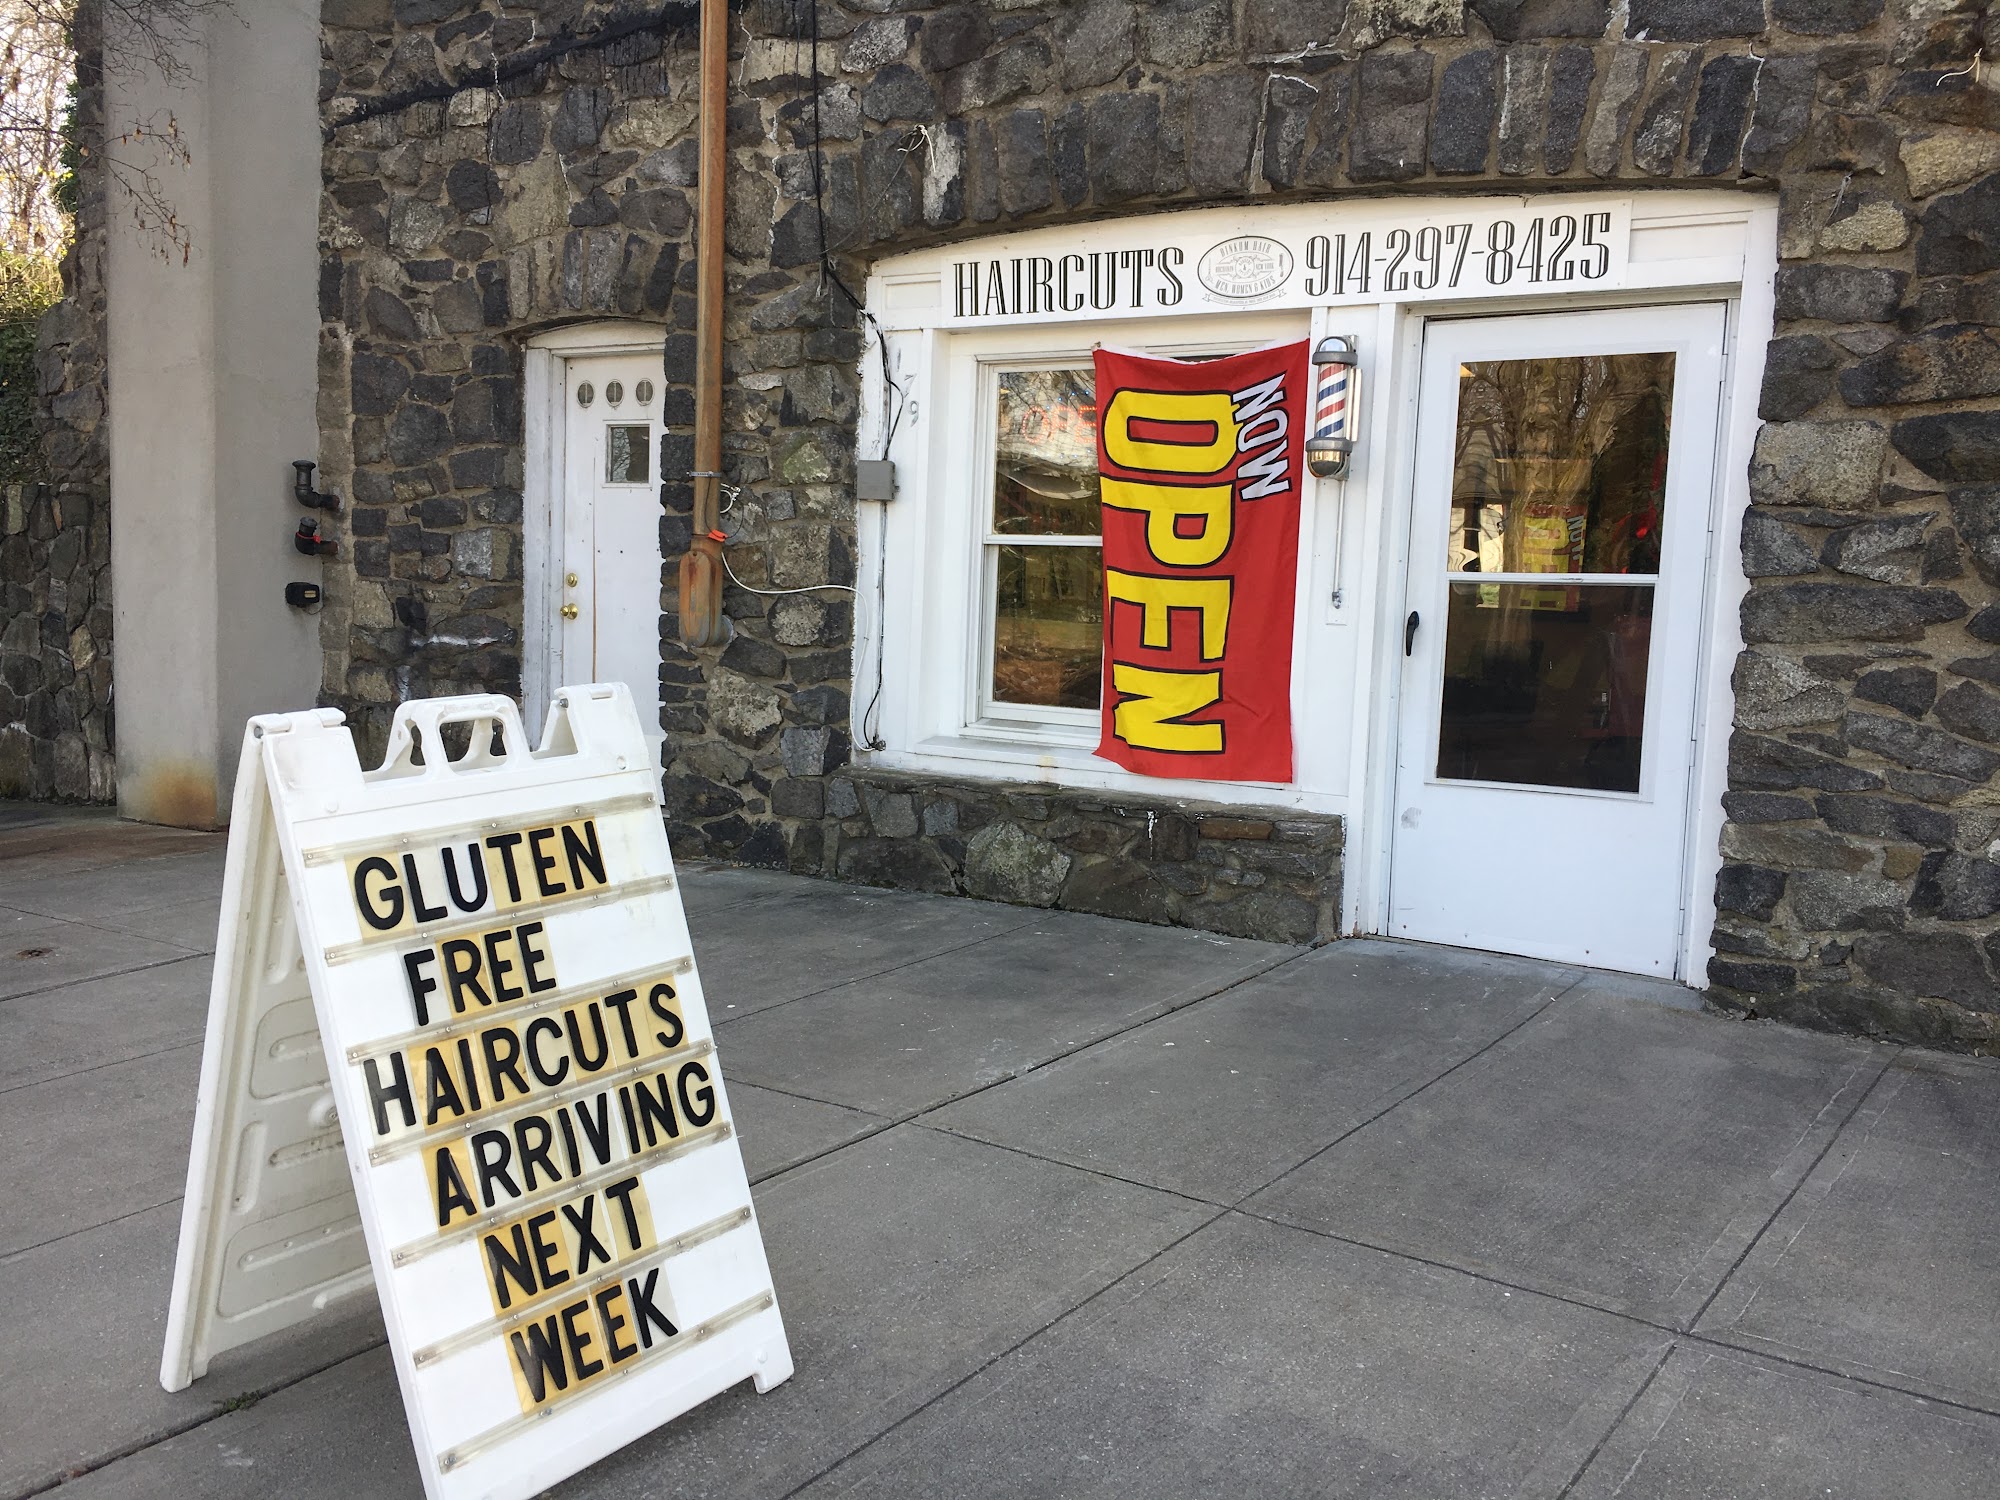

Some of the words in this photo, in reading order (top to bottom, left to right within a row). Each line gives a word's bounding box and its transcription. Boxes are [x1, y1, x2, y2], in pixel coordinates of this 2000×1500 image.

[952, 248, 1185, 318] HAIRCUTS
[1305, 212, 1611, 297] 914-297-8425
[1021, 404, 1096, 443] OPE
[1231, 371, 1294, 501] NOW
[1100, 388, 1242, 754] OPEN
[354, 820, 607, 931] GLUTEN
[404, 921, 558, 1027] FREE
[364, 983, 684, 1136] HAIRCUTS
[436, 1061, 716, 1227] ARRIVING
[483, 1176, 642, 1309] NEXT
[512, 1267, 679, 1403] WEEK
